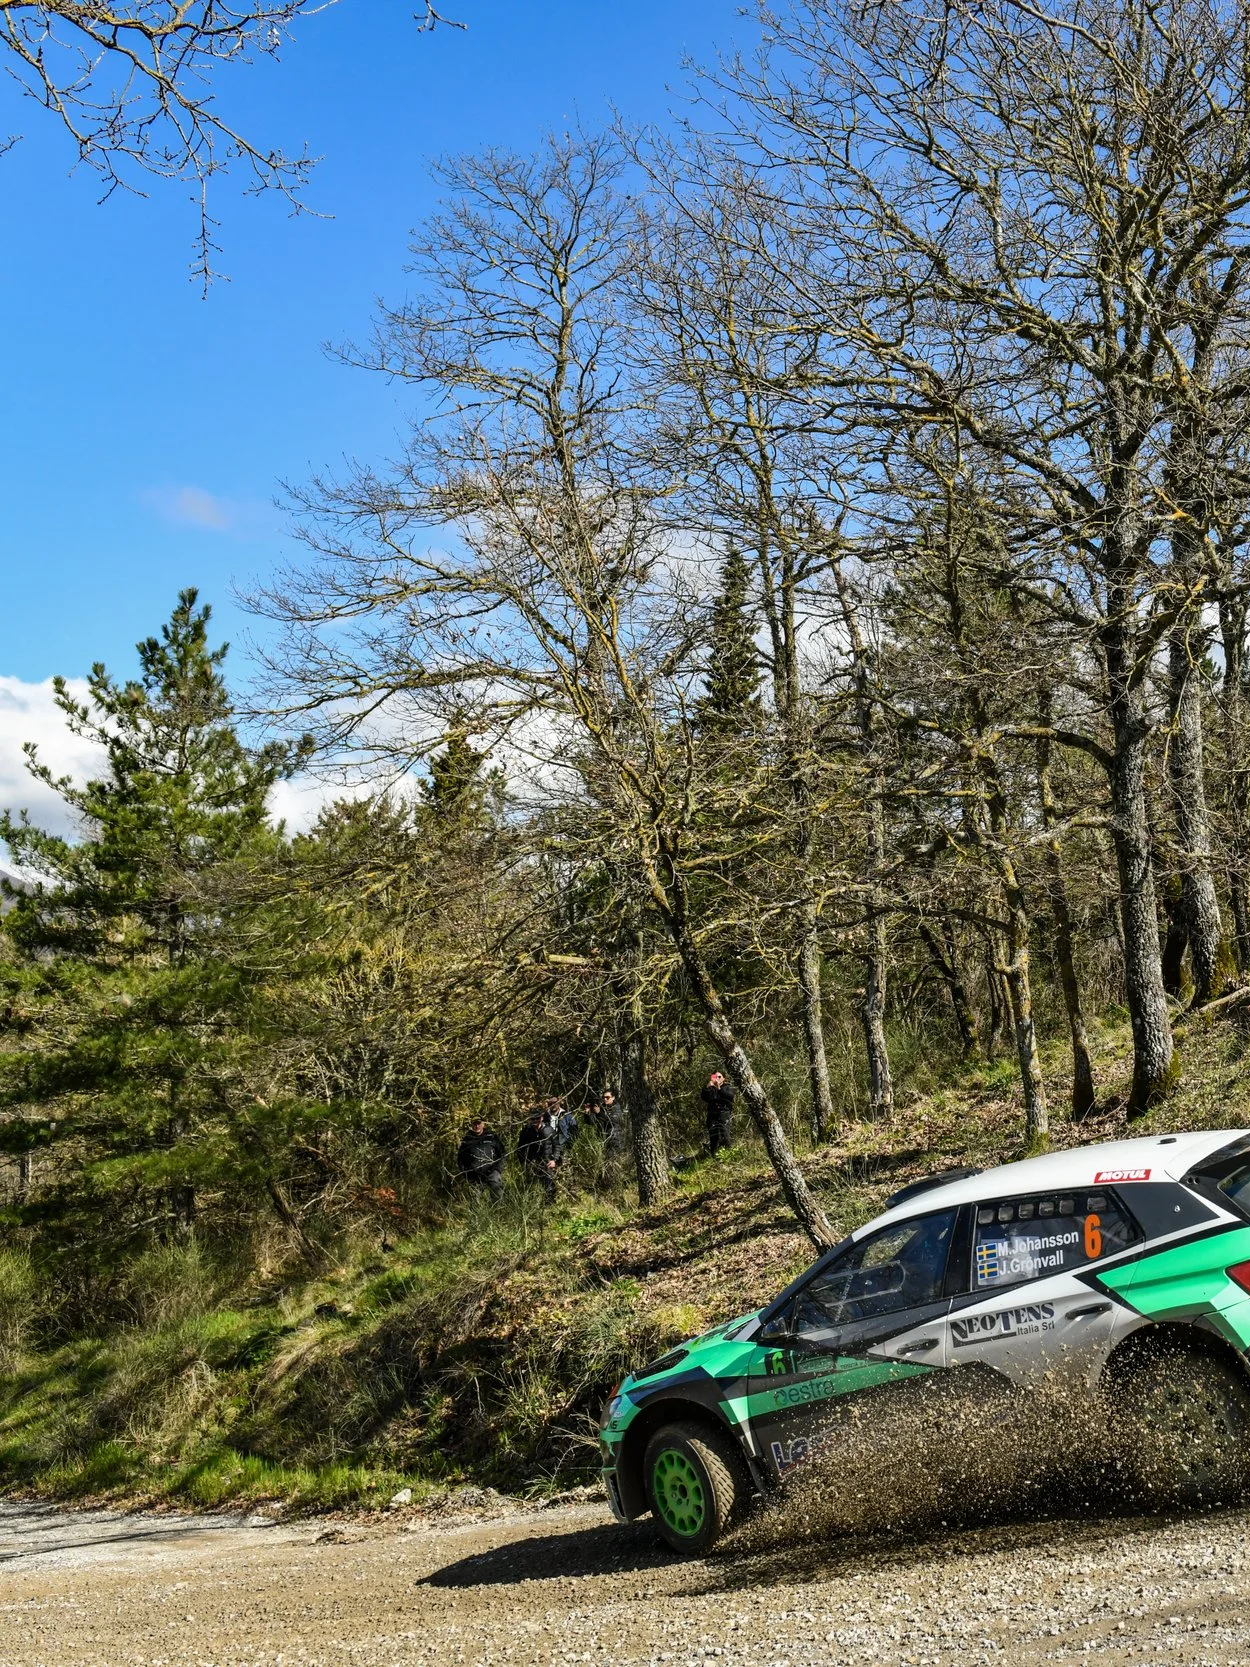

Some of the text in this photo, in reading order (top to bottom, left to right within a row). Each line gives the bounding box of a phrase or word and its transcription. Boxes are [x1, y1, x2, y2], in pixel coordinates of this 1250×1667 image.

[1098, 1169, 1147, 1181] MOTUL
[998, 1231, 1079, 1257] M.Johansson
[1083, 1213, 1101, 1259] 6
[999, 1250, 1064, 1276] J.Grönvall
[949, 1302, 1055, 1346] NEOTENS
[1017, 1320, 1055, 1336] Italia Srl
